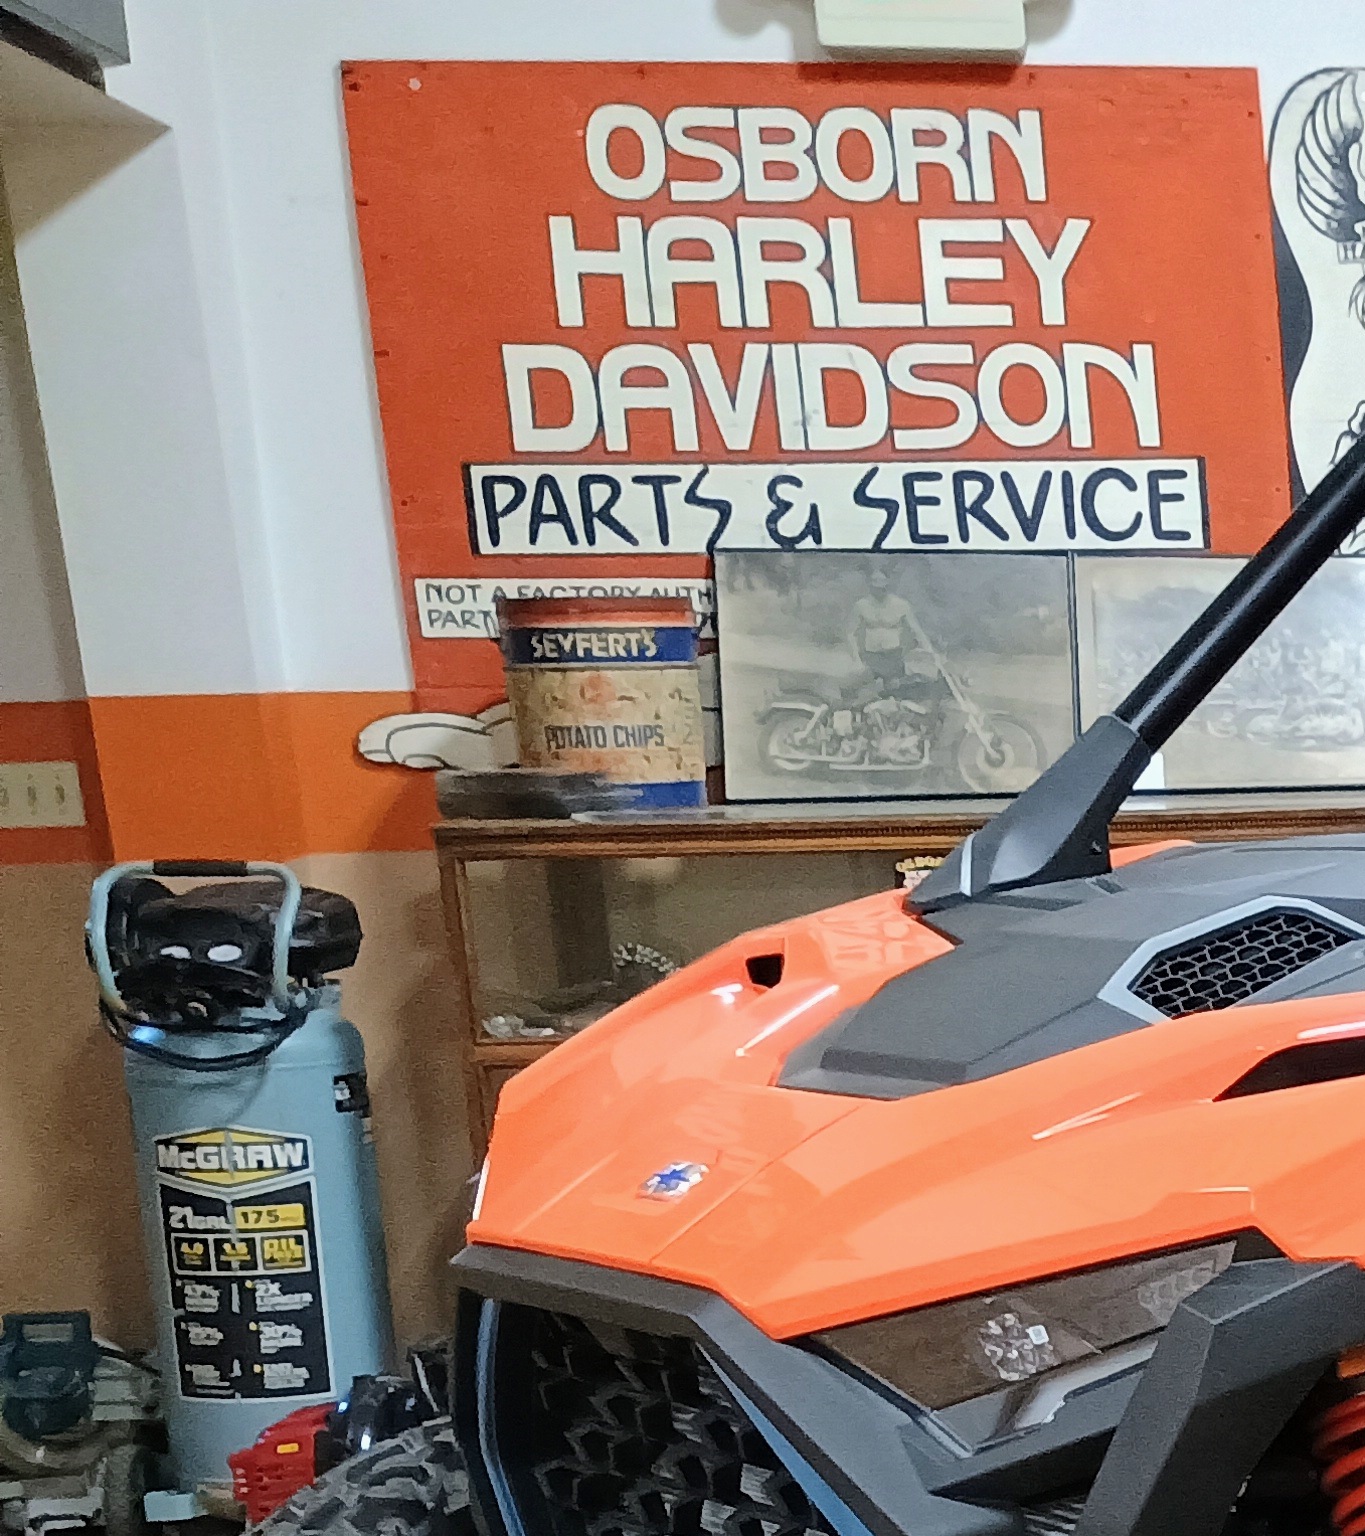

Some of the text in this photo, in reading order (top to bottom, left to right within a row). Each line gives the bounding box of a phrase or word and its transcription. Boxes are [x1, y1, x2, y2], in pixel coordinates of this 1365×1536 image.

[585, 104, 1047, 203] OSBORN
[547, 215, 1091, 328] HARLEY
[500, 342, 1162, 455] DAVIDSON
[480, 465, 1193, 552] PARTS & SERVICE
[425, 583, 482, 605] NOT
[544, 724, 664, 750] POTATO CHIPS
[158, 1142, 304, 1170] McGRAW
[240, 1209, 280, 1223] 175
